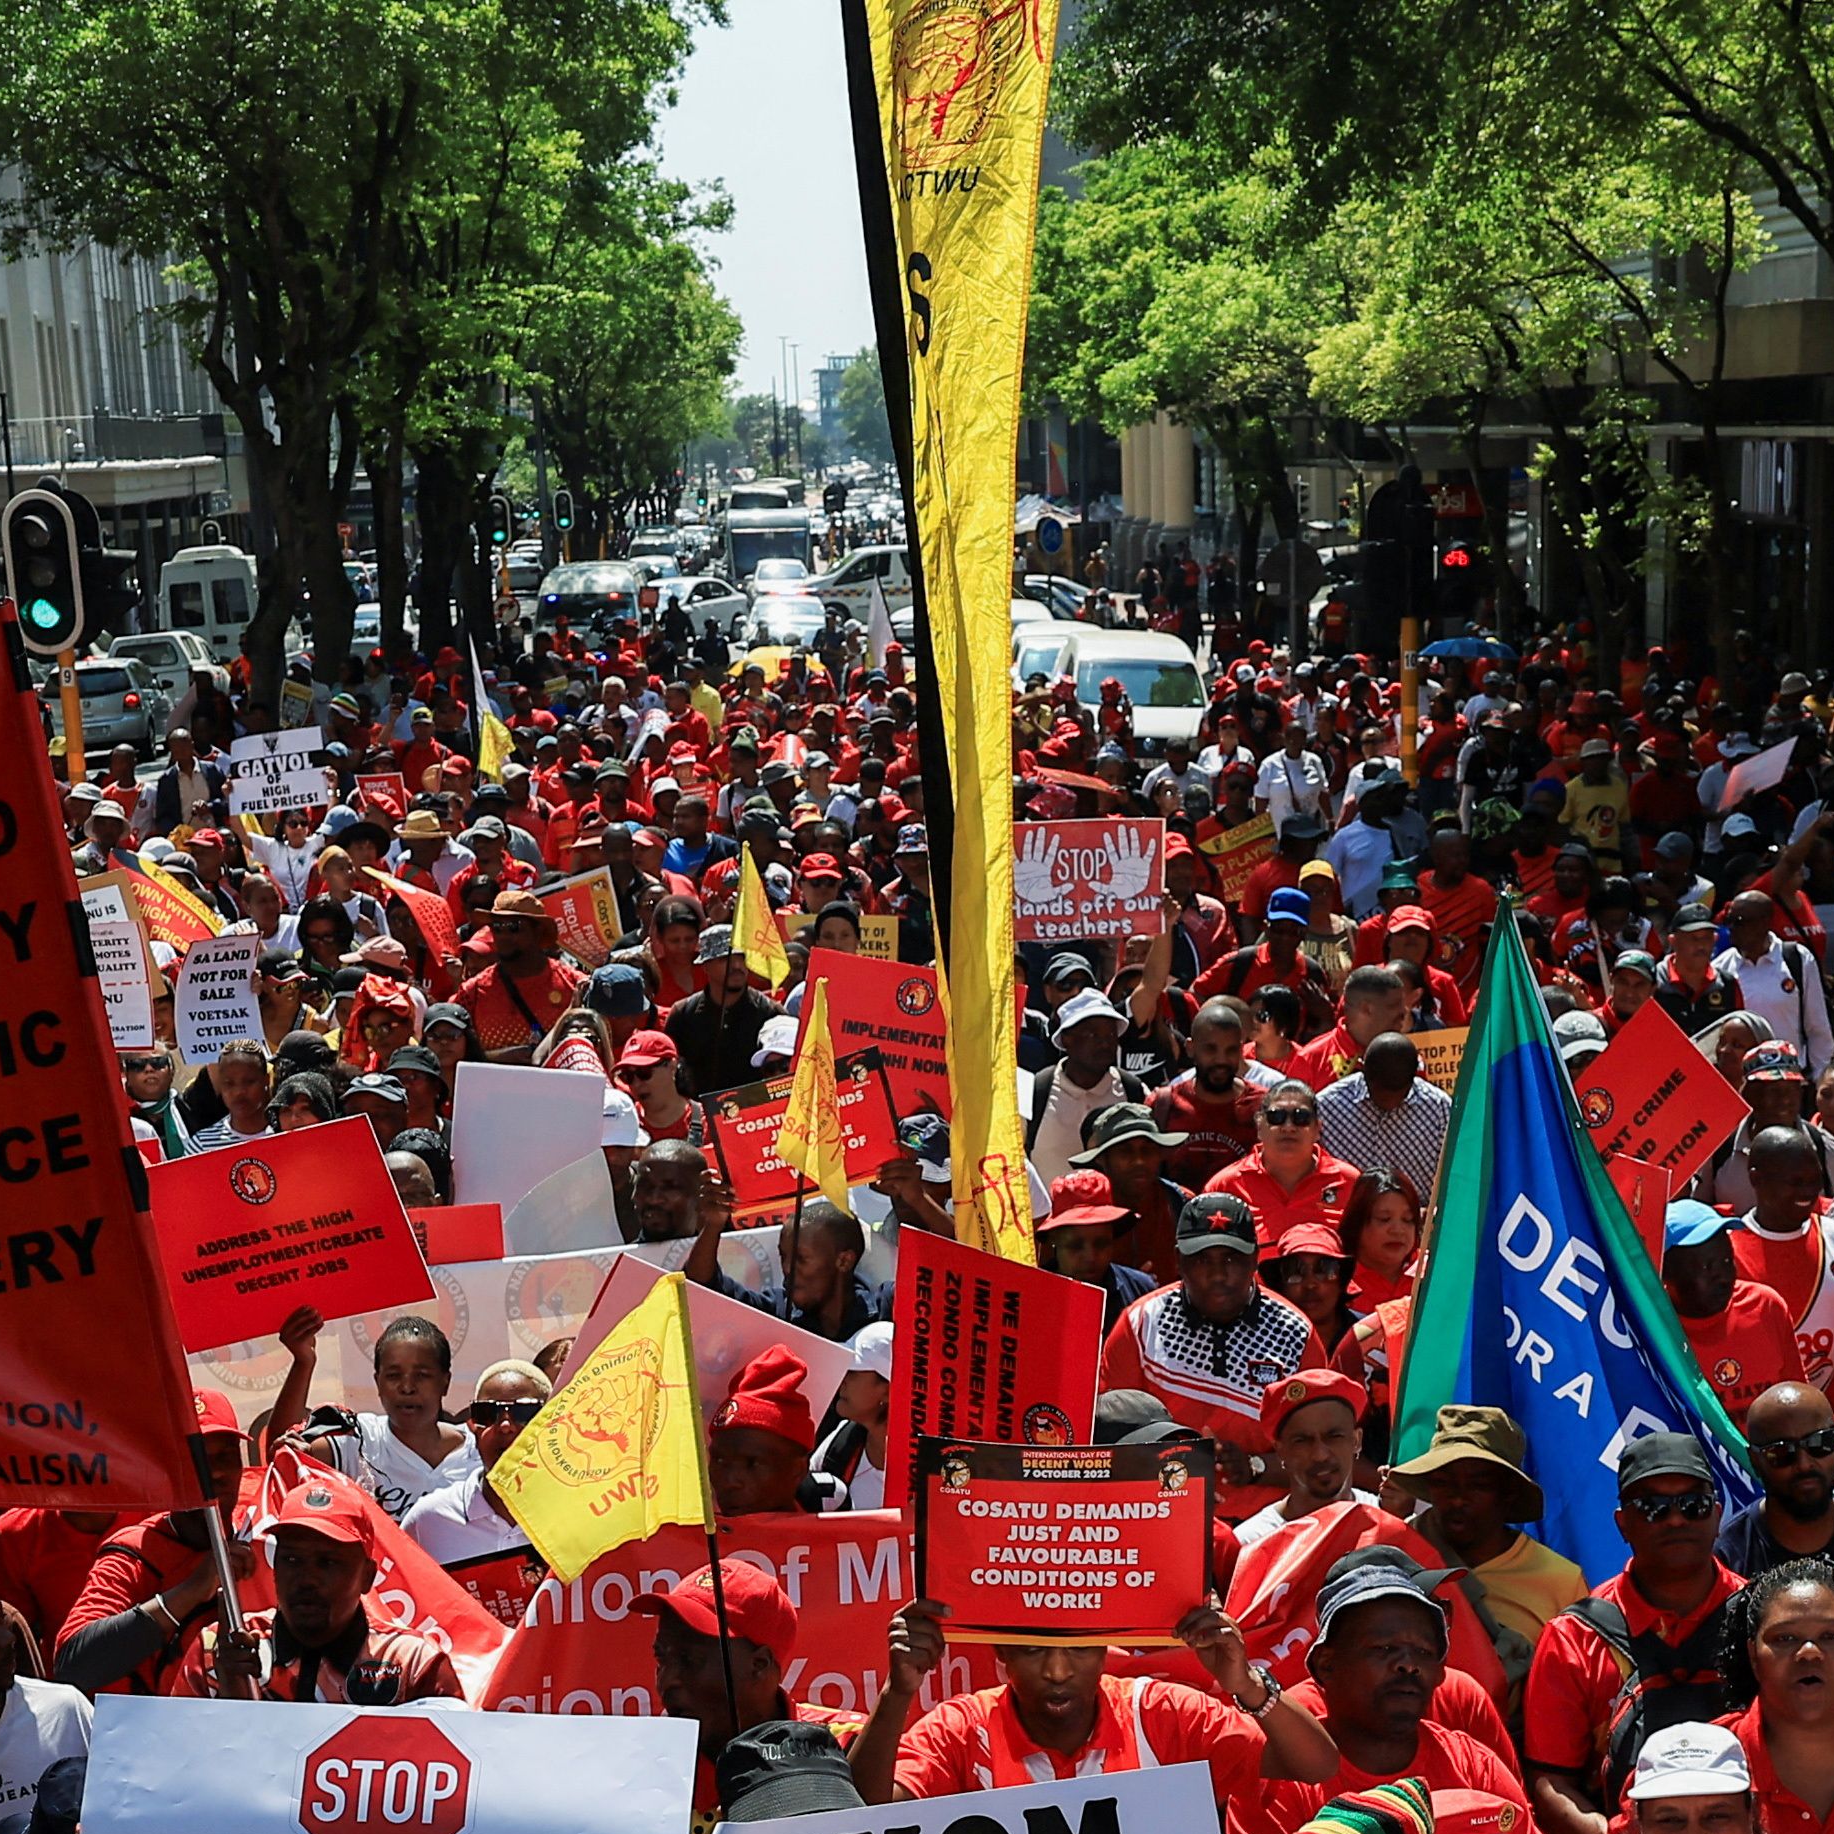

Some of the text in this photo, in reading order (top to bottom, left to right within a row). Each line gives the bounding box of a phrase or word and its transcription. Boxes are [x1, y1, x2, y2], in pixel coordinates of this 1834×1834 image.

[63, 668, 73, 686] 9
[237, 753, 314, 779] GATVOL
[267, 773, 282, 785] OF
[262, 784, 291, 798] HIGH
[241, 792, 320, 812] FUEL PRICES!
[1056, 847, 1108, 881] STOP
[1078, 893, 1162, 914] off our
[1033, 913, 1134, 938] teachers
[192, 949, 251, 965] SA LAND
[188, 969, 248, 985] NOT FOR
[199, 988, 236, 1001] SALE
[188, 1008, 250, 1021] VOETSAK
[196, 1208, 356, 1259] ADDRESS THE HIGH
[233, 1256, 351, 1296] DECENT JOBS
[1022, 1450, 1076, 1460] INTERNATIONAL
[1022, 1458, 1112, 1470] DECENT WORK
[1030, 1468, 1111, 1479] OCTOBER 2022
[957, 1500, 1171, 1520] COSATU DEMANDS
[1006, 1525, 1120, 1543] JUST AND
[988, 1546, 1139, 1566] FAVOURABLE
[969, 1569, 1156, 1588] CONDITIONS OF
[1022, 1591, 1102, 1610] WORK!
[311, 1757, 460, 1826] STOP
